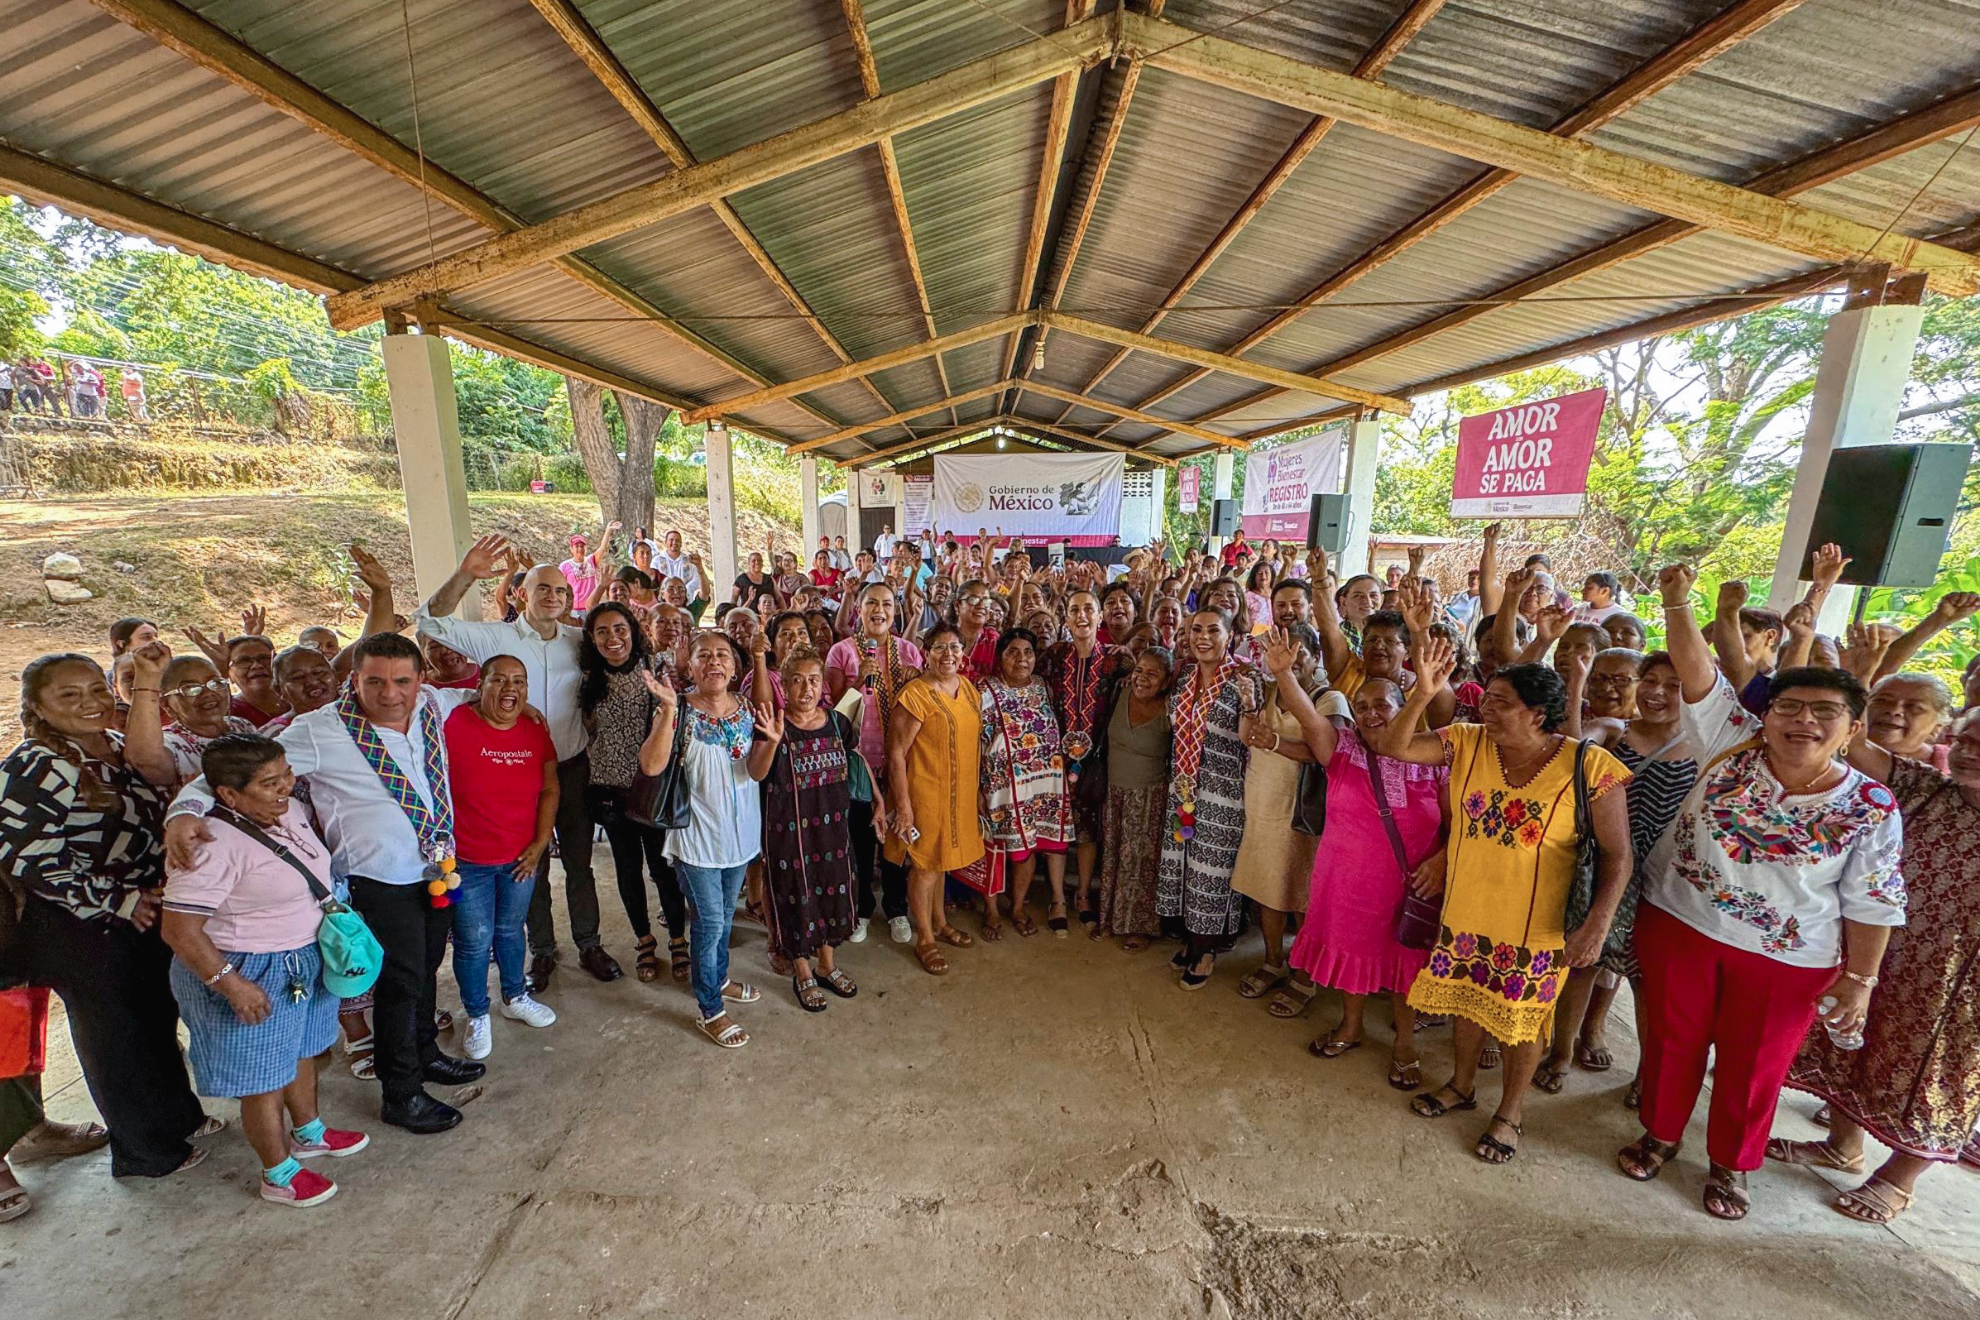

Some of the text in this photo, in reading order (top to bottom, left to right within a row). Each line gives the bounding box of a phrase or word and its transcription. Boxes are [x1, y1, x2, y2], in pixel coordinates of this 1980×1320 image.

[1487, 402, 1560, 441] AMOR
[1278, 454, 1302, 469] Mujeres
[1482, 438, 1553, 473] AMOR
[989, 485, 1054, 494] Gobierno de
[1479, 469, 1546, 494] SE PAGA
[1269, 482, 1308, 503] REGISTRO
[989, 495, 1053, 510] México
[480, 747, 532, 759] Aeropostale
